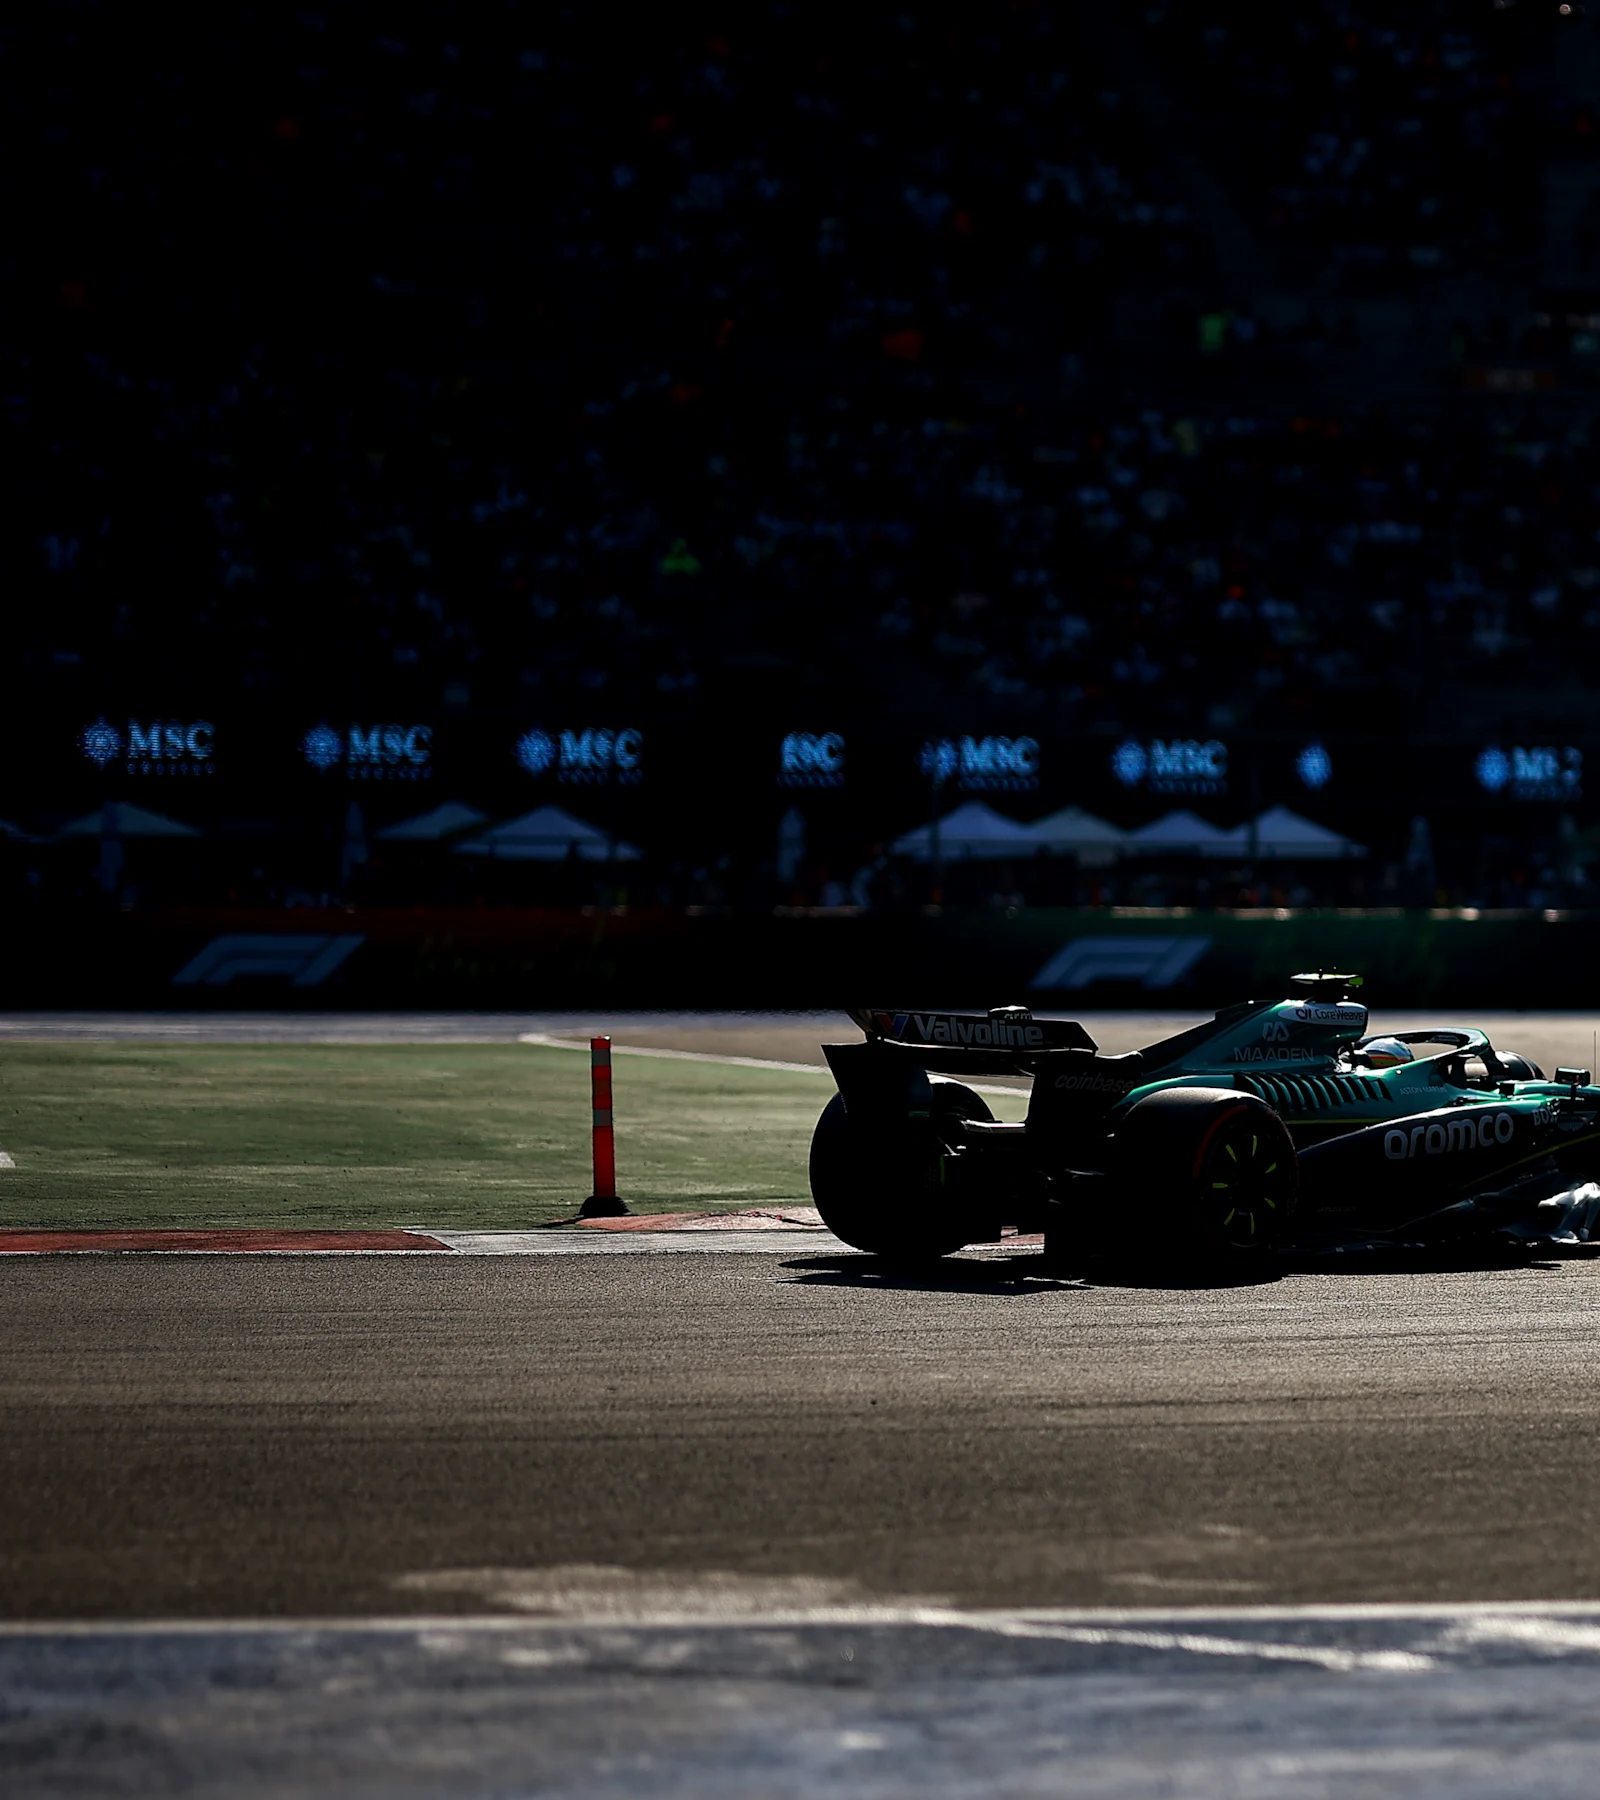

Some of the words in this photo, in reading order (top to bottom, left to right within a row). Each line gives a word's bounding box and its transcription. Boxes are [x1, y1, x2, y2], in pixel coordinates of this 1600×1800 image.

[127, 718, 216, 759] MSC
[347, 721, 433, 764] MSC
[559, 727, 643, 768] MSC
[958, 735, 1041, 776] MSC
[914, 1014, 1044, 1046] Valvoline
[1315, 1008, 1364, 1021] CoreWeave
[1234, 1046, 1315, 1062] MAADEN
[1055, 1071, 1135, 1093] coinbase
[1400, 1086, 1421, 1096] ASTON
[1422, 1084, 1448, 1094] MARTIN
[1383, 1111, 1515, 1160] aramco
